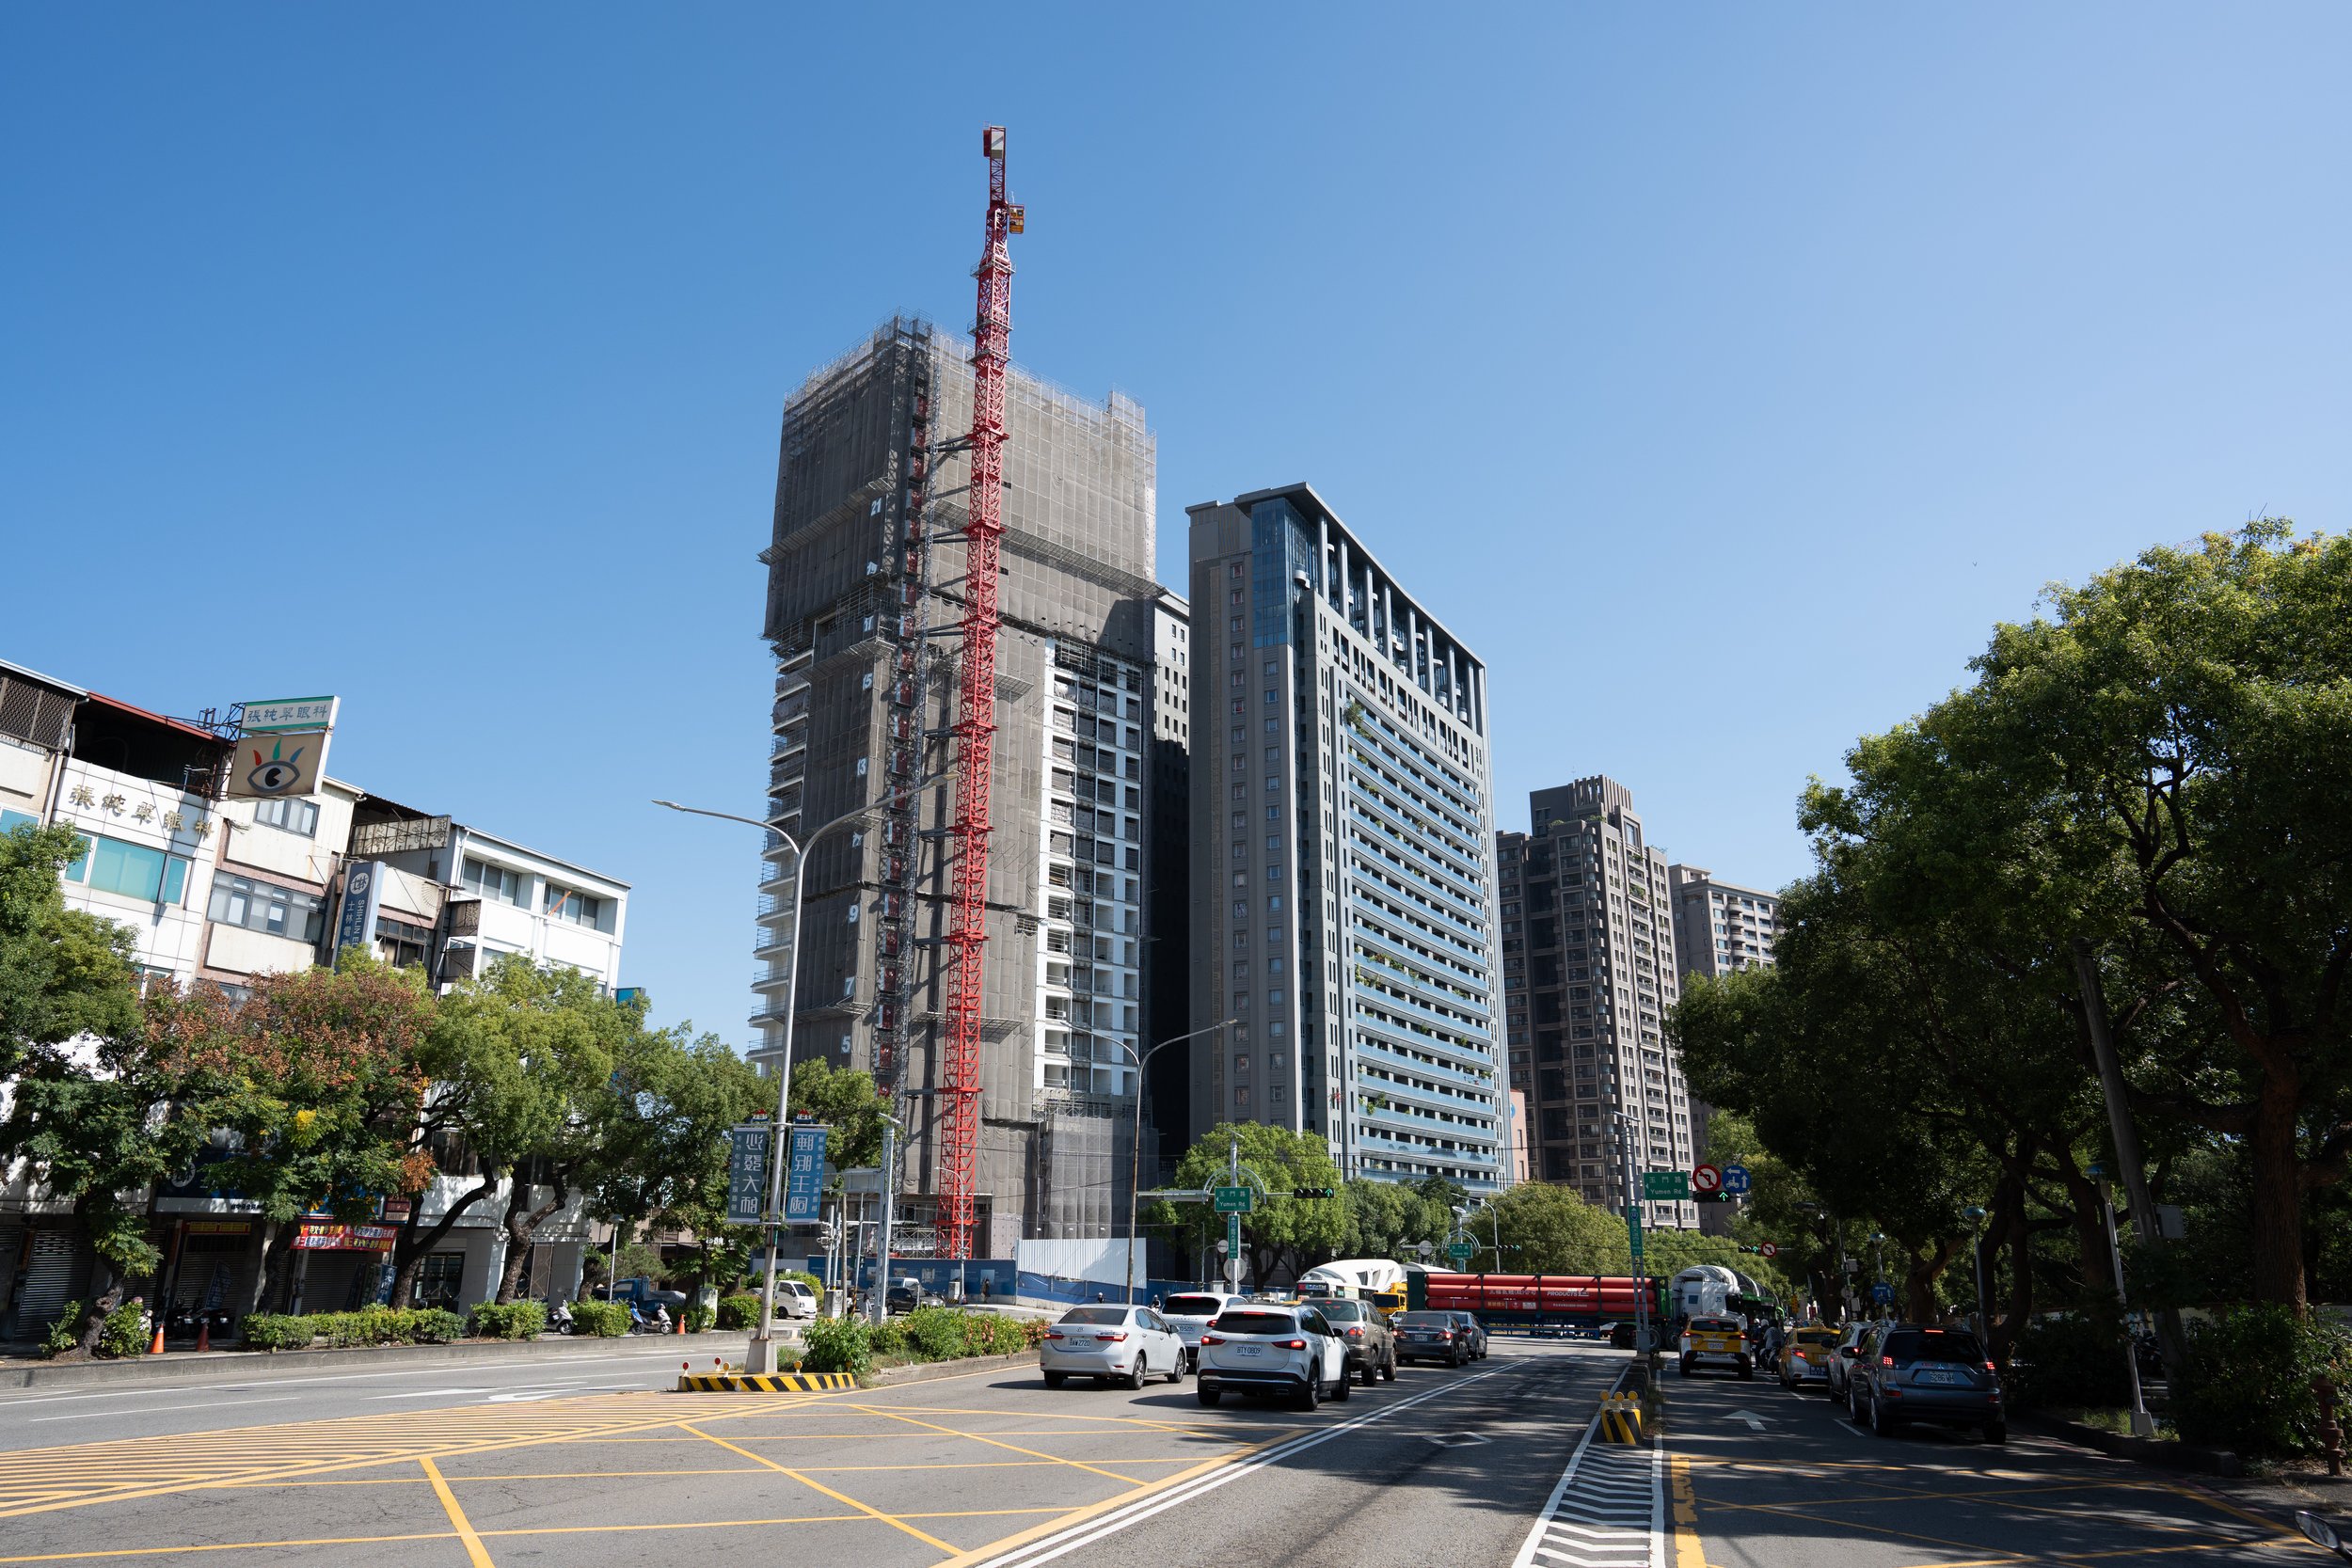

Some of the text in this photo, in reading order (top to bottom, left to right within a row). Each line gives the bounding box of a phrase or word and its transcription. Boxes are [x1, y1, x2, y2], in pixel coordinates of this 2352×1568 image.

[870, 498, 882, 516] 21
[863, 673, 873, 690] 15
[354, 899, 365, 934] SHIHLIN
[849, 904, 859, 922] 9
[845, 976, 855, 994] 7
[841, 1036, 851, 1053] 5
